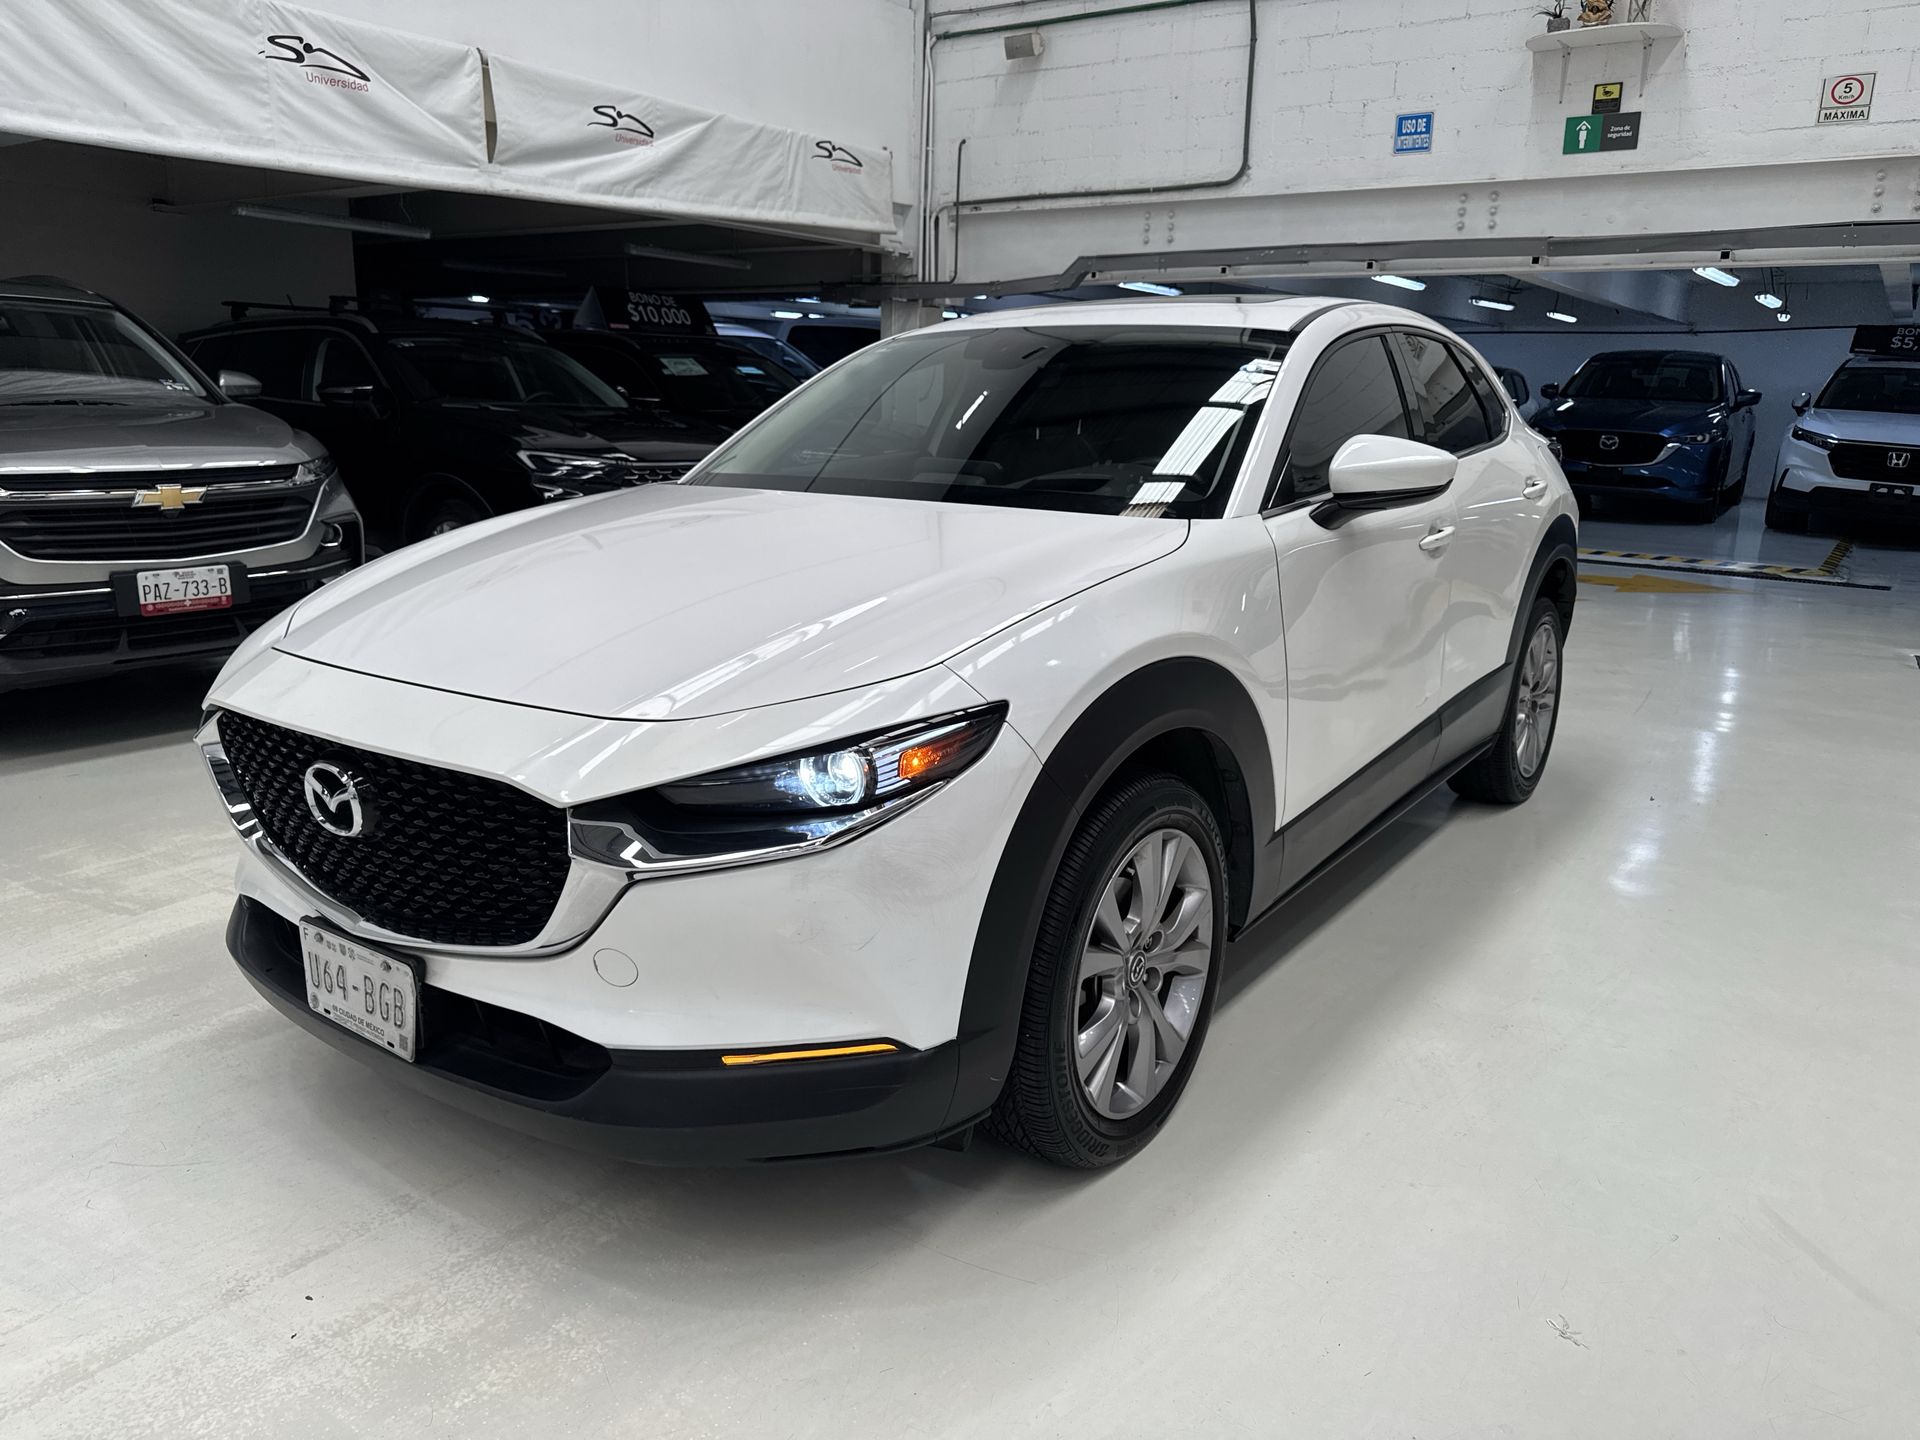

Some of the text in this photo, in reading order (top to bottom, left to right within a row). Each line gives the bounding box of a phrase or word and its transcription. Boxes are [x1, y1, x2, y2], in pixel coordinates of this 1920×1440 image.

[305, 71, 370, 93] Universidad
[1843, 82, 1854, 94] 5
[1401, 118, 1427, 134] USO DE
[1607, 131, 1633, 139] seguridad
[628, 291, 678, 307] BONO DE
[627, 303, 692, 325] $10,000
[142, 577, 229, 602] PAZ-733-B
[307, 951, 404, 1029] U64-BGB
[338, 1007, 358, 1023] CIUDAD
[357, 1017, 365, 1027] DE
